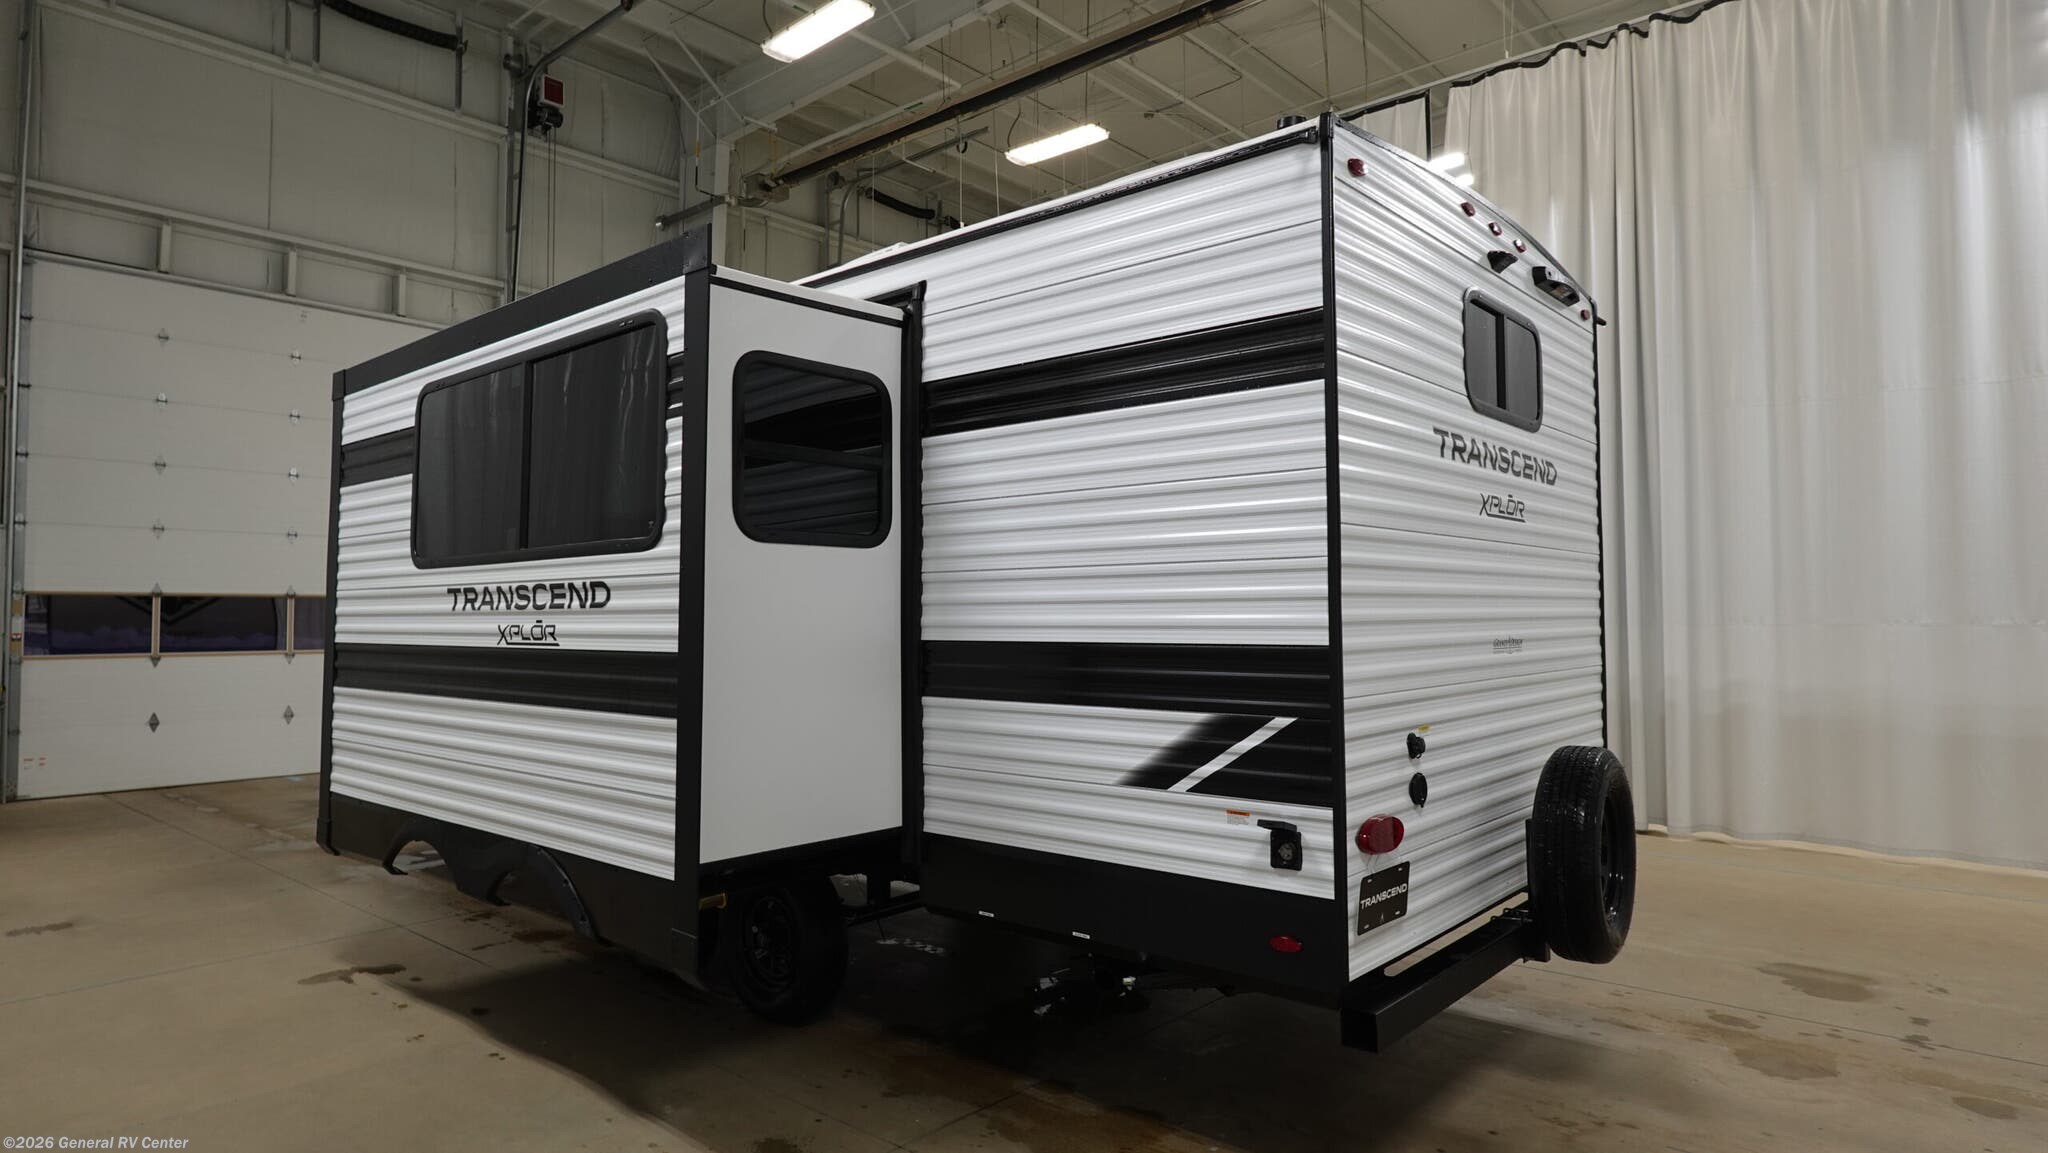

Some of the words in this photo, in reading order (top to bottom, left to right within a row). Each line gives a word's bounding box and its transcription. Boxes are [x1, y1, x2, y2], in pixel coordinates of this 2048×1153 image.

[1433, 426, 1558, 485] TRANSCEND
[447, 581, 611, 611] TRANSCEND
[1360, 883, 1408, 910] TRANSCEND
